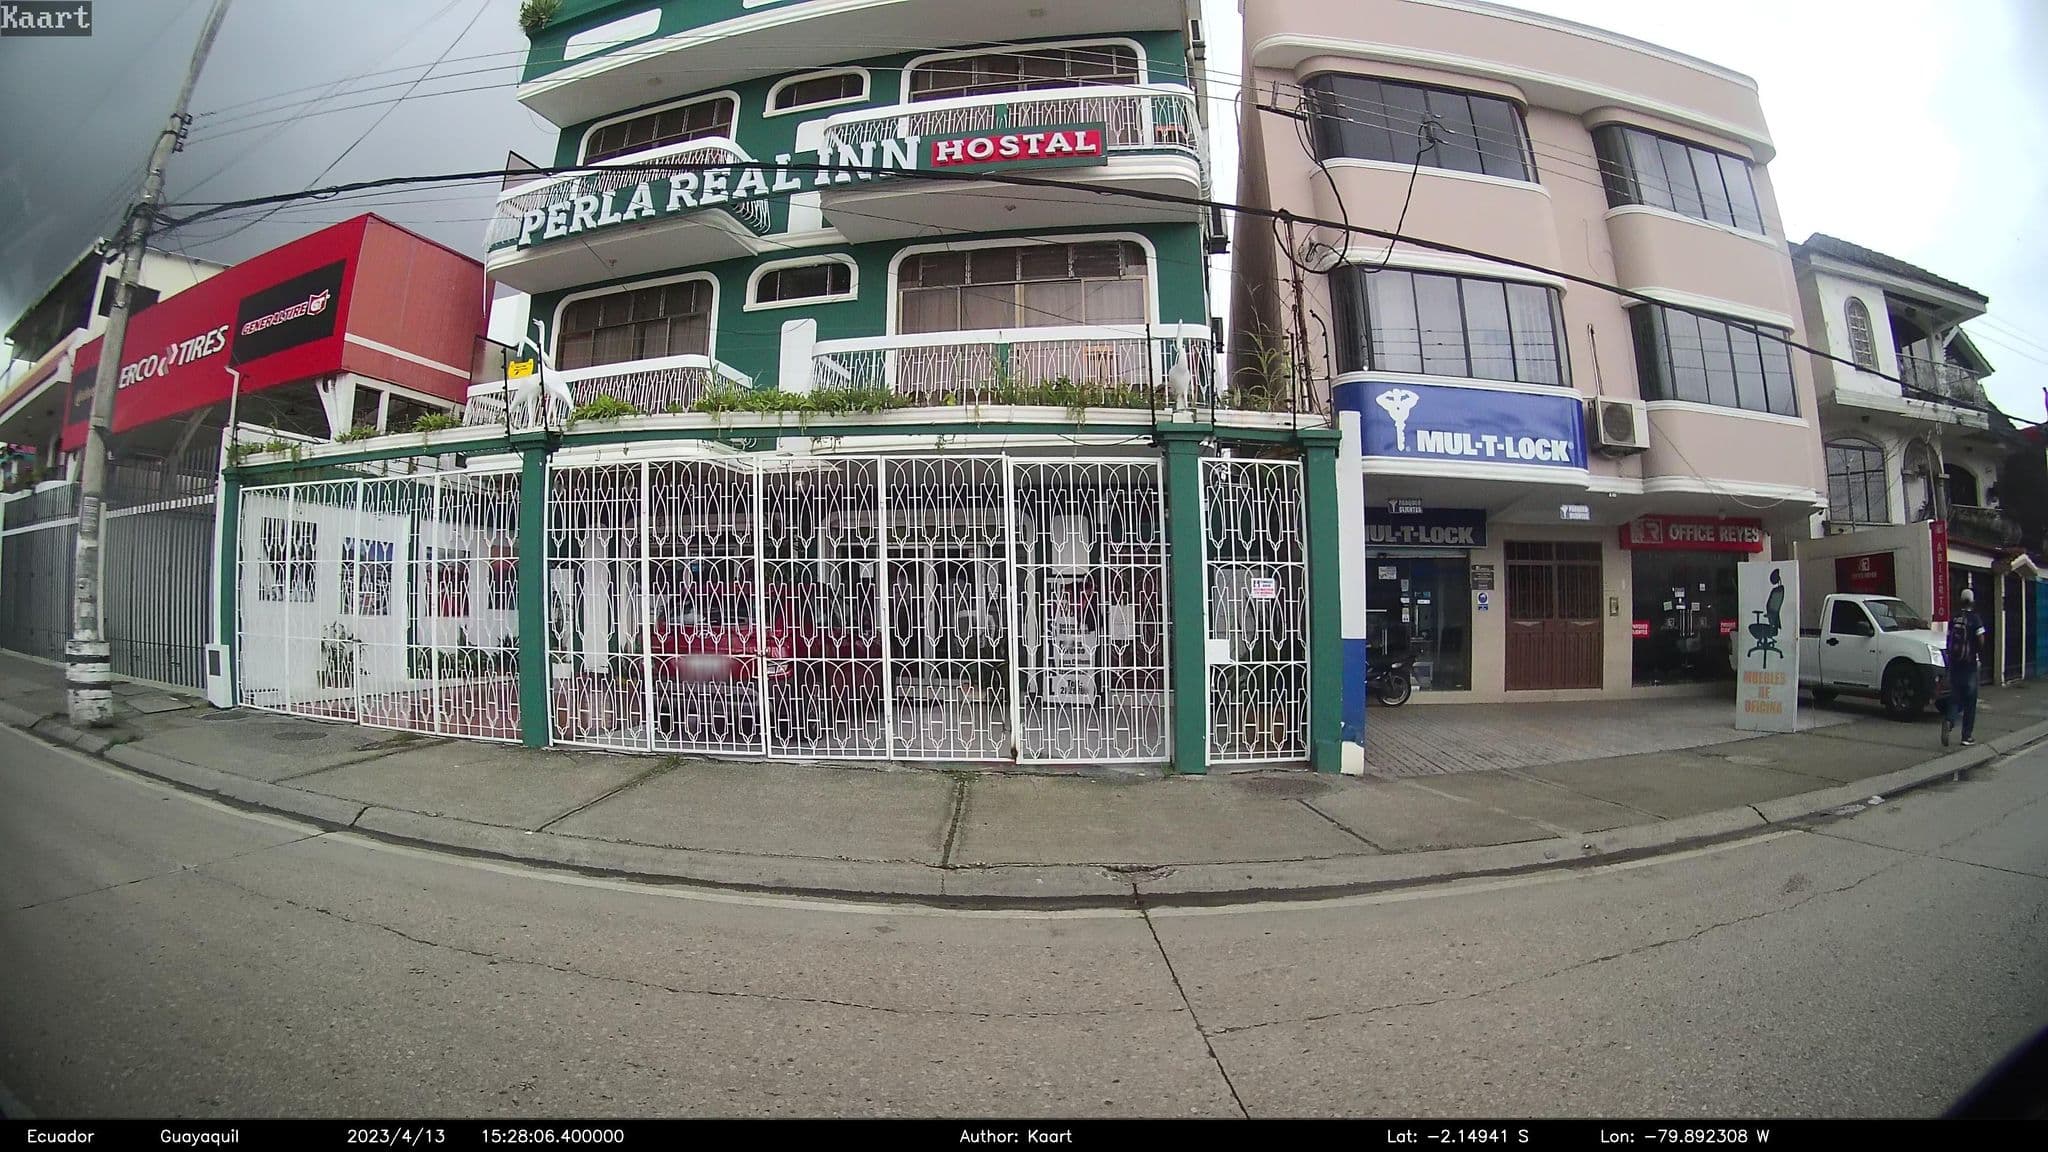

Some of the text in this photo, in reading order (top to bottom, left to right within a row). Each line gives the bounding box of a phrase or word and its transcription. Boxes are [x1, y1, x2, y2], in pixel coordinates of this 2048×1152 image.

[936, 130, 1097, 162] HOSTAL
[518, 135, 921, 246] PERLA REAL INN
[118, 324, 230, 389] ERCO TIRES
[1416, 430, 1571, 462] MUL-T-LOCK
[1669, 524, 1760, 543] OFFICE REYES
[1936, 541, 1945, 616] ABIERTO
[1743, 671, 1786, 686] MUEBLES
[1744, 700, 1783, 715] OFICINA
